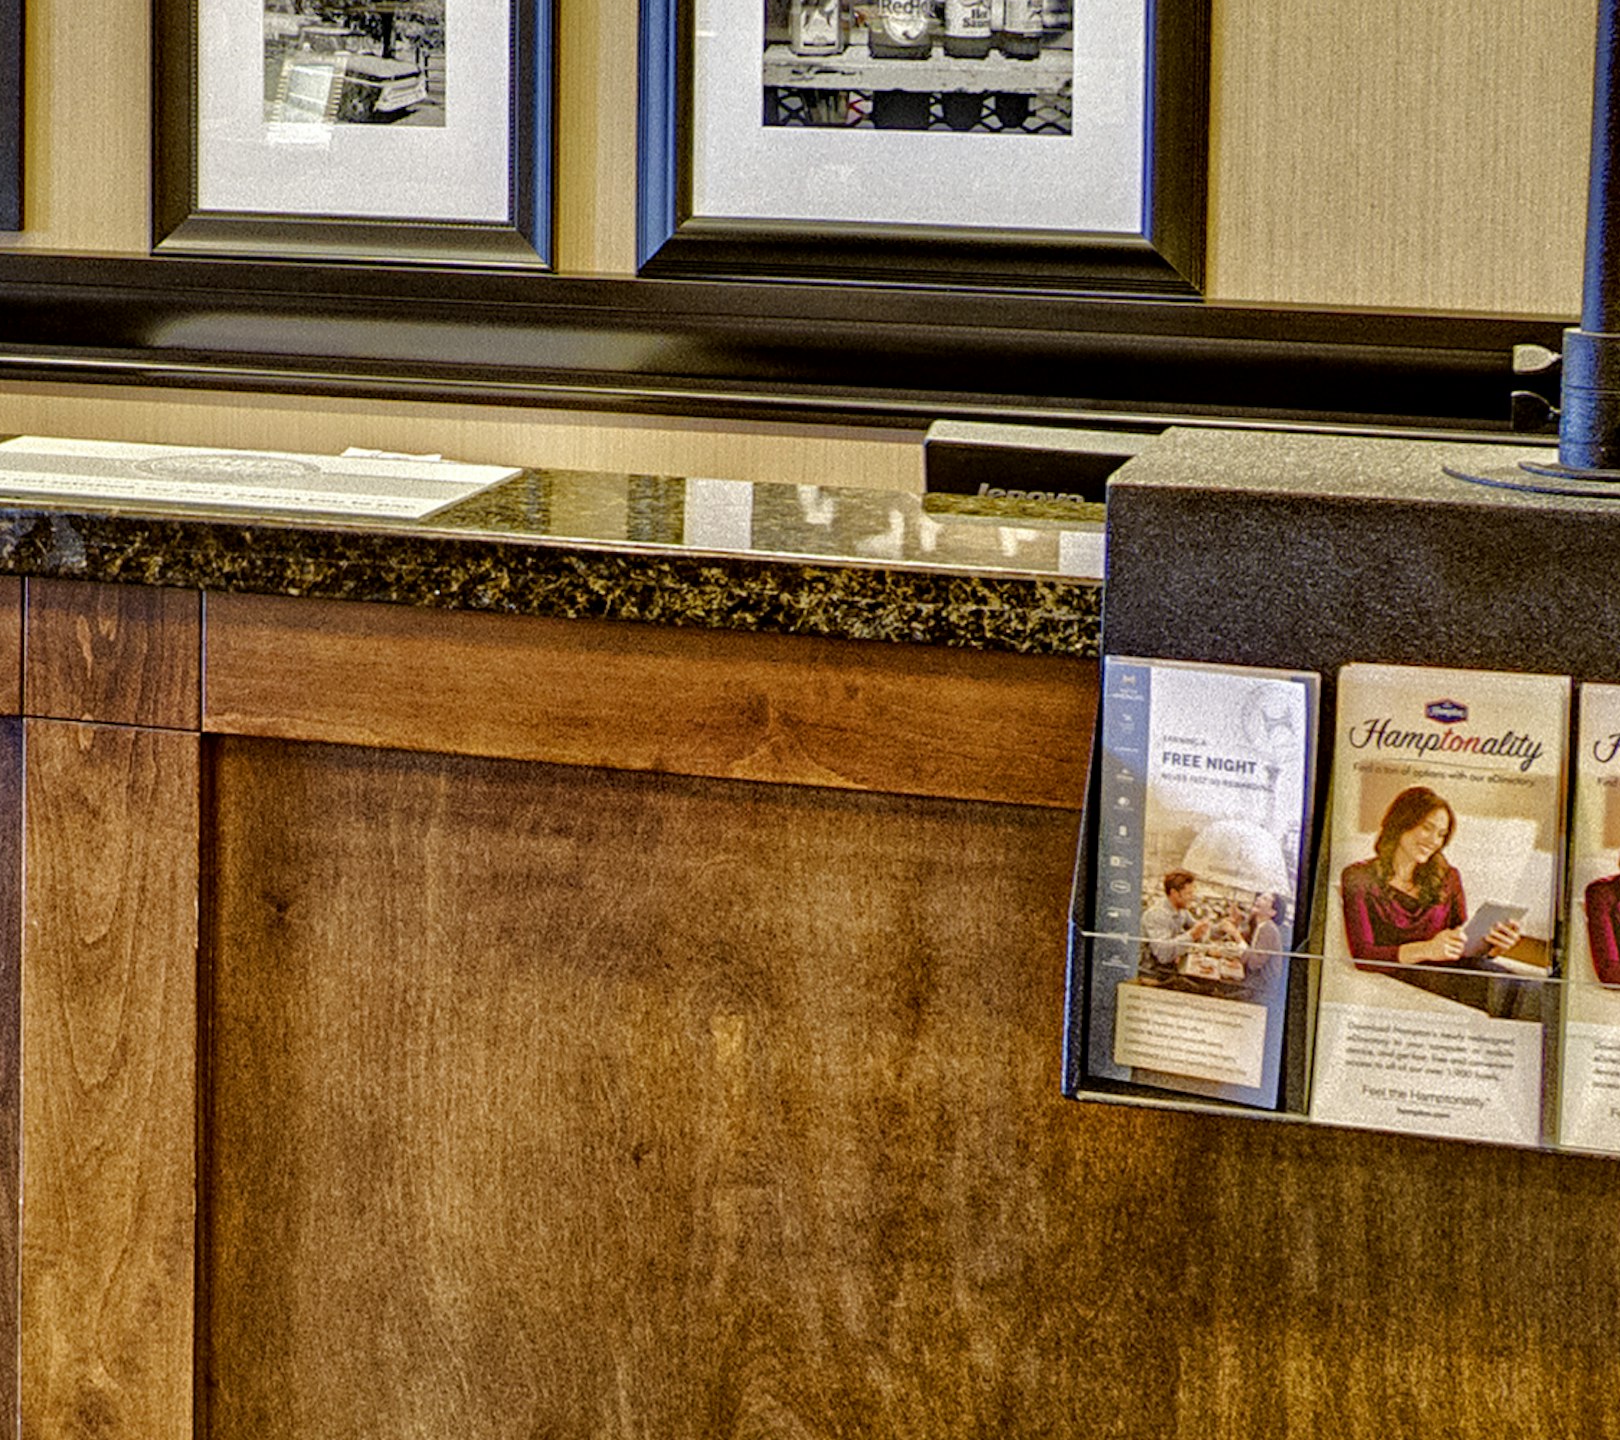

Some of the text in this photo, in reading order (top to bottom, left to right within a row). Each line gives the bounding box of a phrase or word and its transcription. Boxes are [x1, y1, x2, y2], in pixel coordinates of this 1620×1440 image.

[1162, 752, 1258, 775] FREE NIGHT
[1349, 717, 1544, 772] Hamptonality
